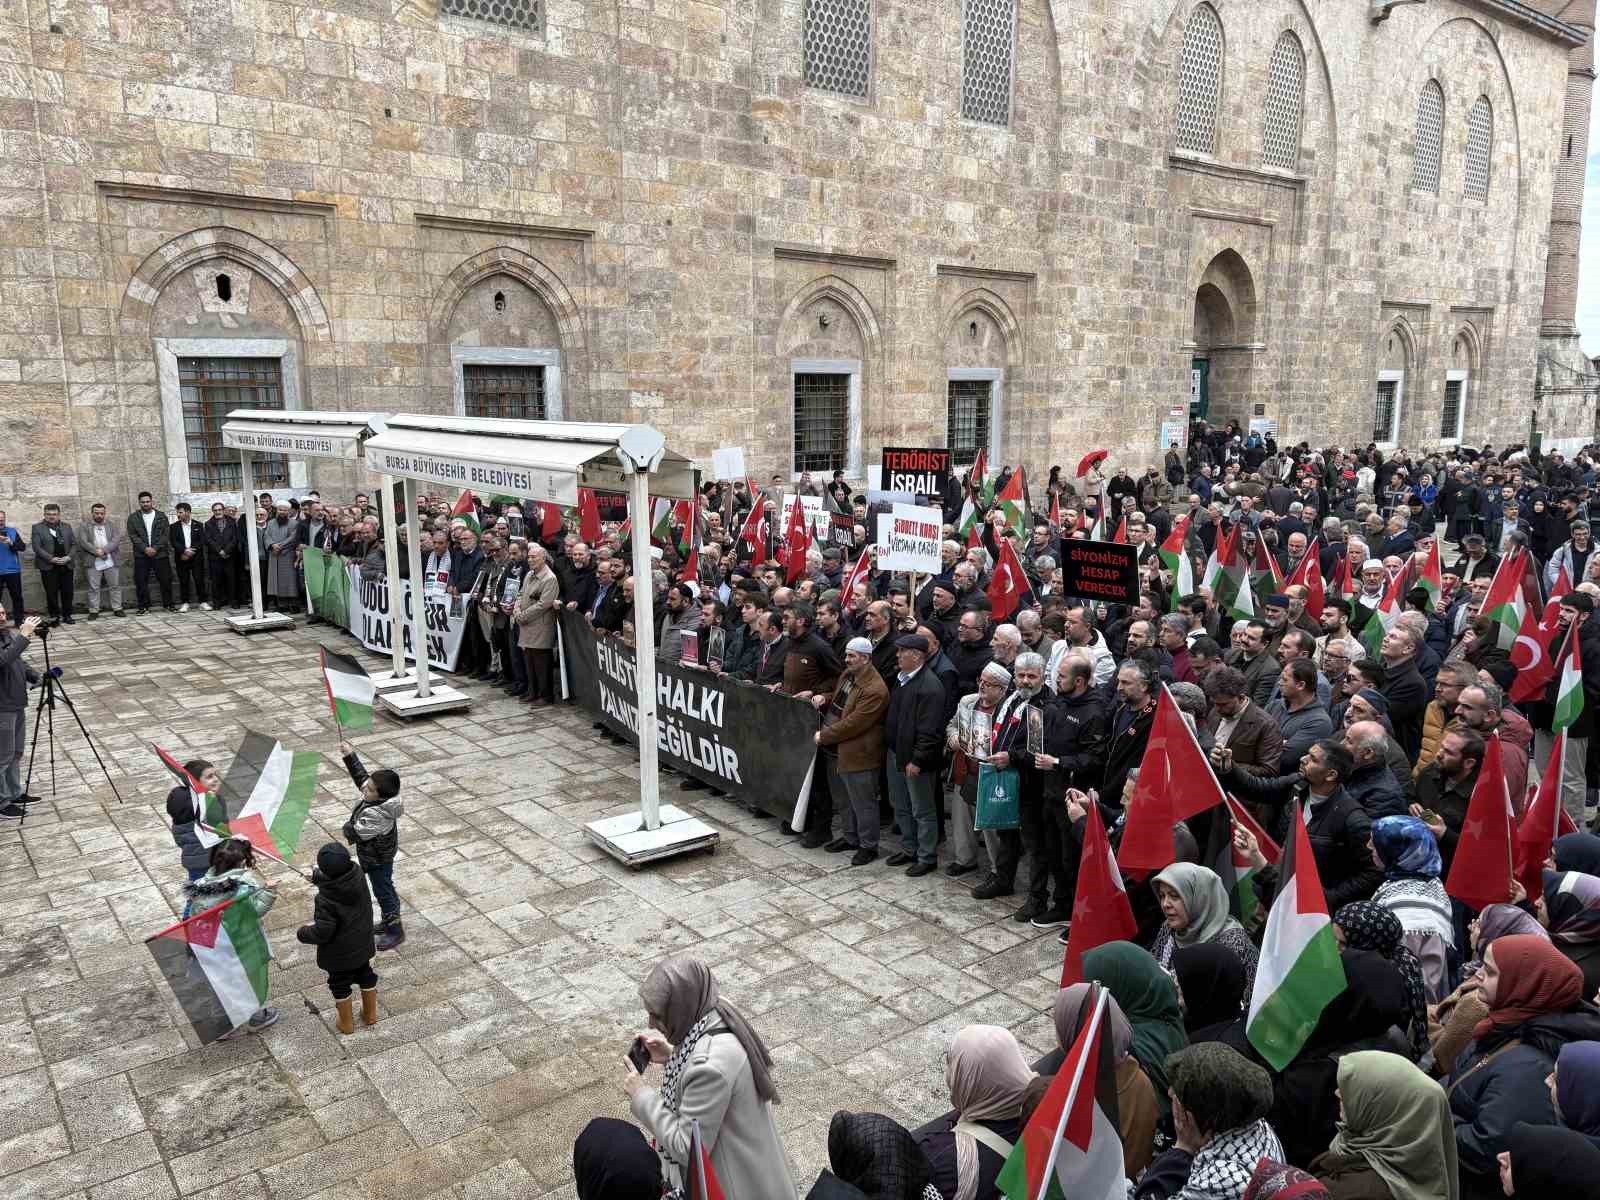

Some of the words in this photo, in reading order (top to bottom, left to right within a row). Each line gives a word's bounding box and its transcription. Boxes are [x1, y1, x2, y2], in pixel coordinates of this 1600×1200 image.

[884, 449, 949, 471] TERÖRİST
[385, 455, 410, 470] BURSA
[413, 457, 466, 481] BÜYÜKŞEHİR
[471, 468, 532, 491] BELEDİYESİ
[890, 470, 940, 495] İSRAİL
[1071, 548, 1128, 566] SİYONİZM
[1081, 566, 1120, 580] HESAP
[1075, 581, 1126, 597] VERECEK
[597, 637, 638, 697] FİLİSTİ
[657, 673, 724, 728] HALKI
[657, 715, 743, 785] EĞİLDİR
